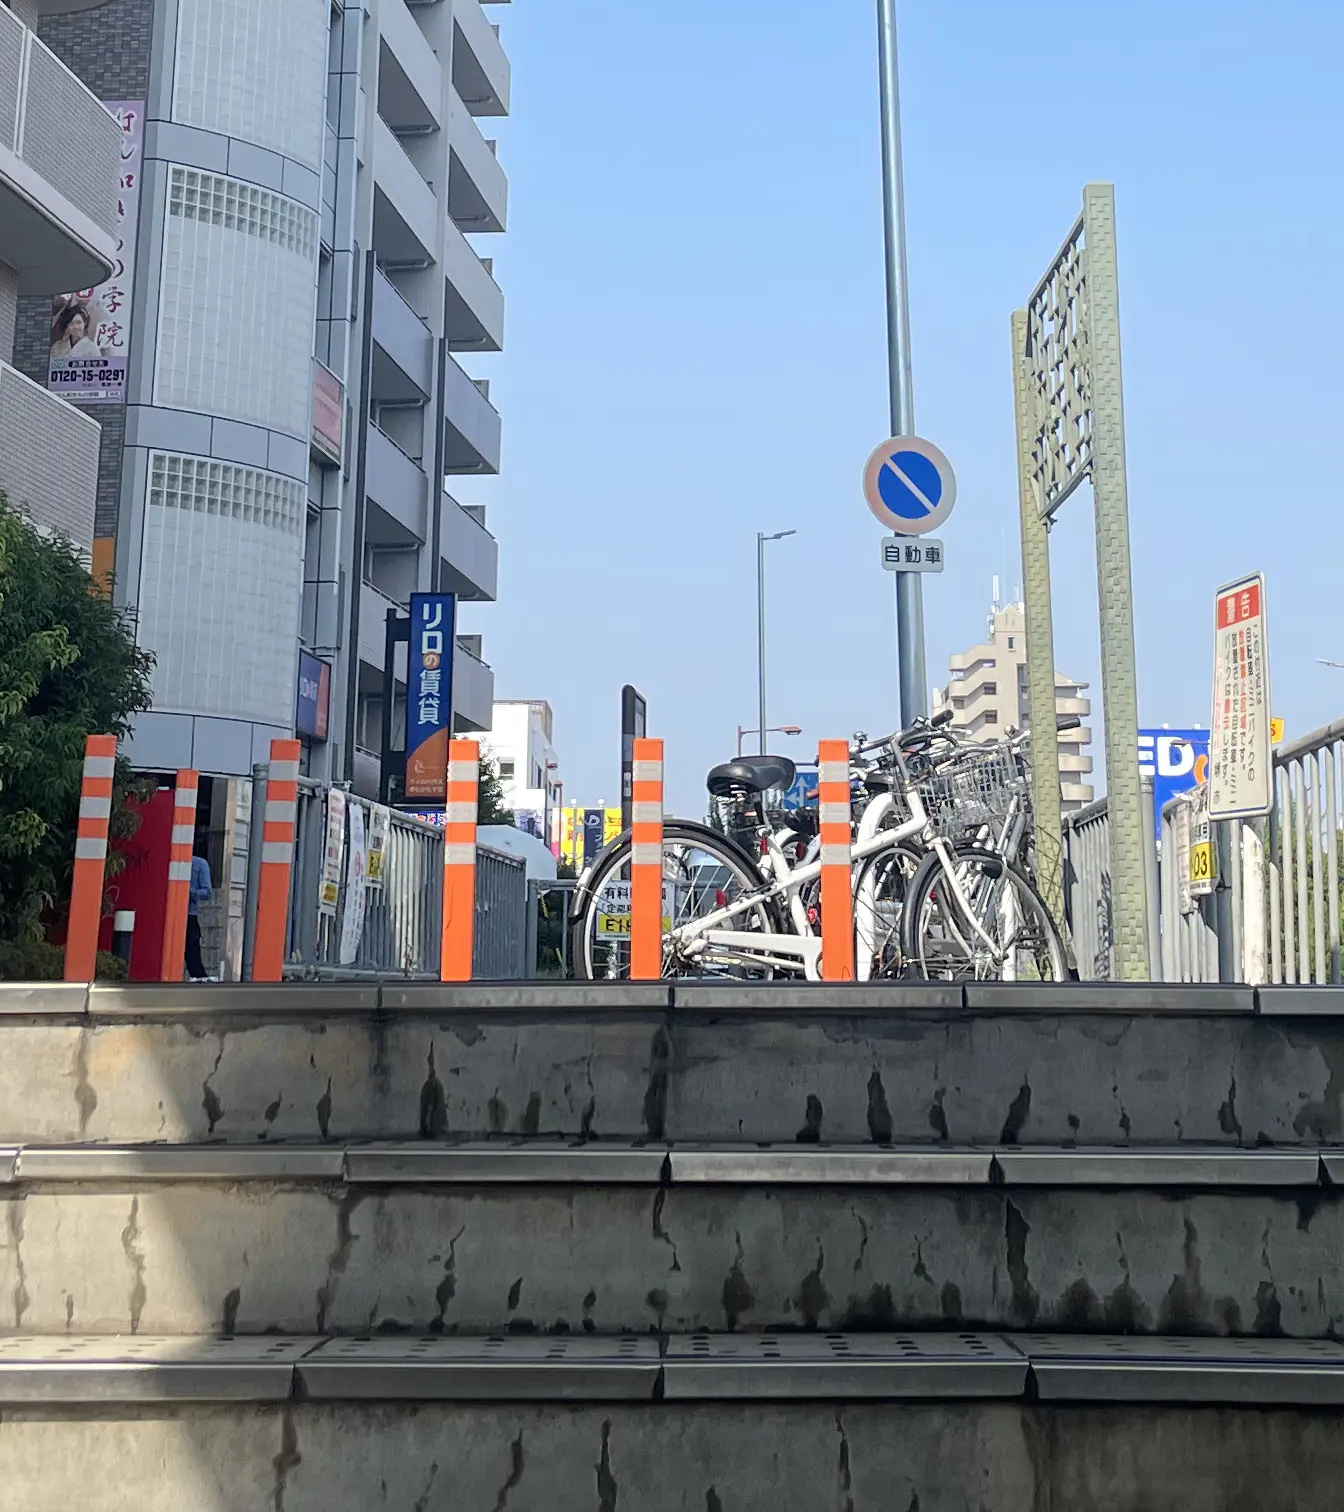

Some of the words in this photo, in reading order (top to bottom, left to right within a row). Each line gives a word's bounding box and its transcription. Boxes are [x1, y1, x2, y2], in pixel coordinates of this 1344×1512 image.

[50, 368, 125, 383] 0120-15-0291
[884, 544, 942, 564] 自動車
[417, 602, 443, 726] リロの賃貸
